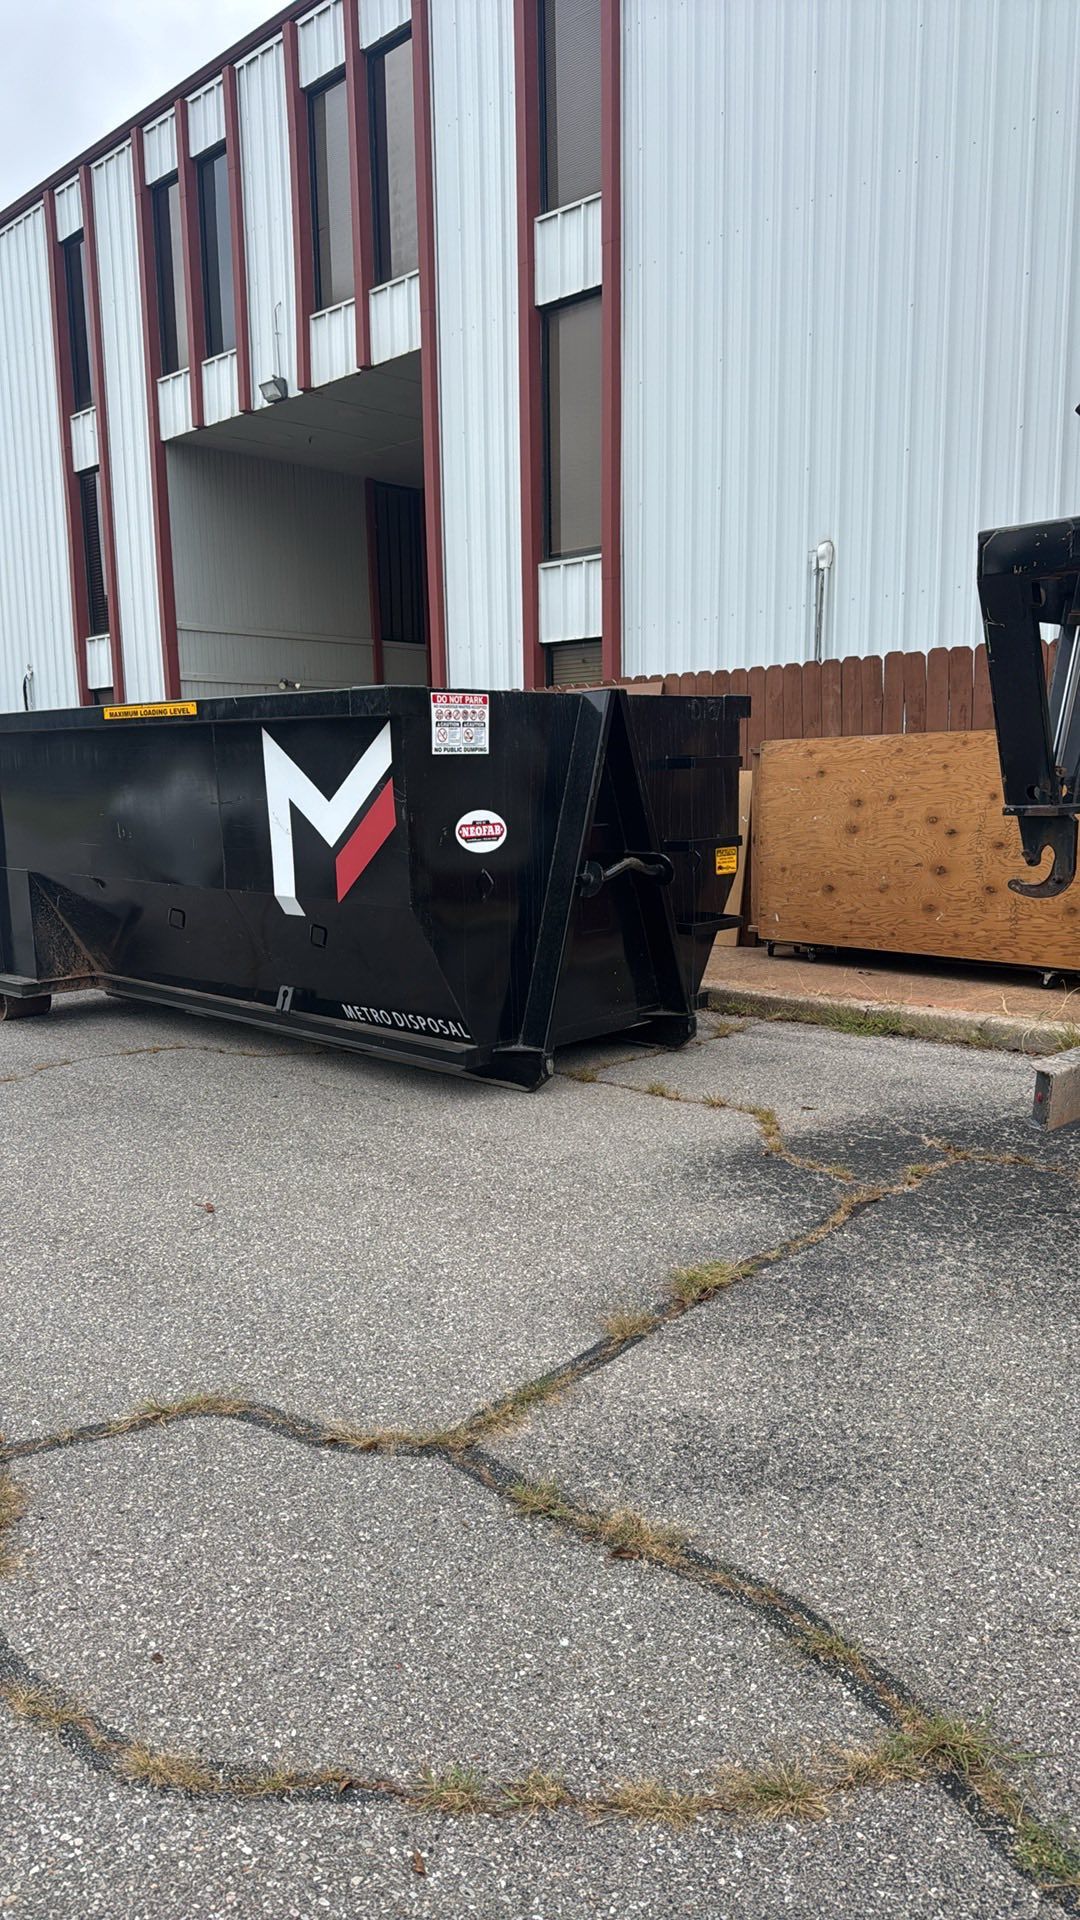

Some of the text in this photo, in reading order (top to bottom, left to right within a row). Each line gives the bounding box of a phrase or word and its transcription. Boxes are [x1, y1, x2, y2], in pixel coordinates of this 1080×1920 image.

[449, 696, 463, 704] NOT
[464, 696, 483, 704] PARK
[140, 708, 168, 717] LOADING
[169, 707, 190, 715] LEVEL
[461, 825, 501, 837] NEOFAB
[341, 1003, 471, 1039] METRO DISPOSAL
